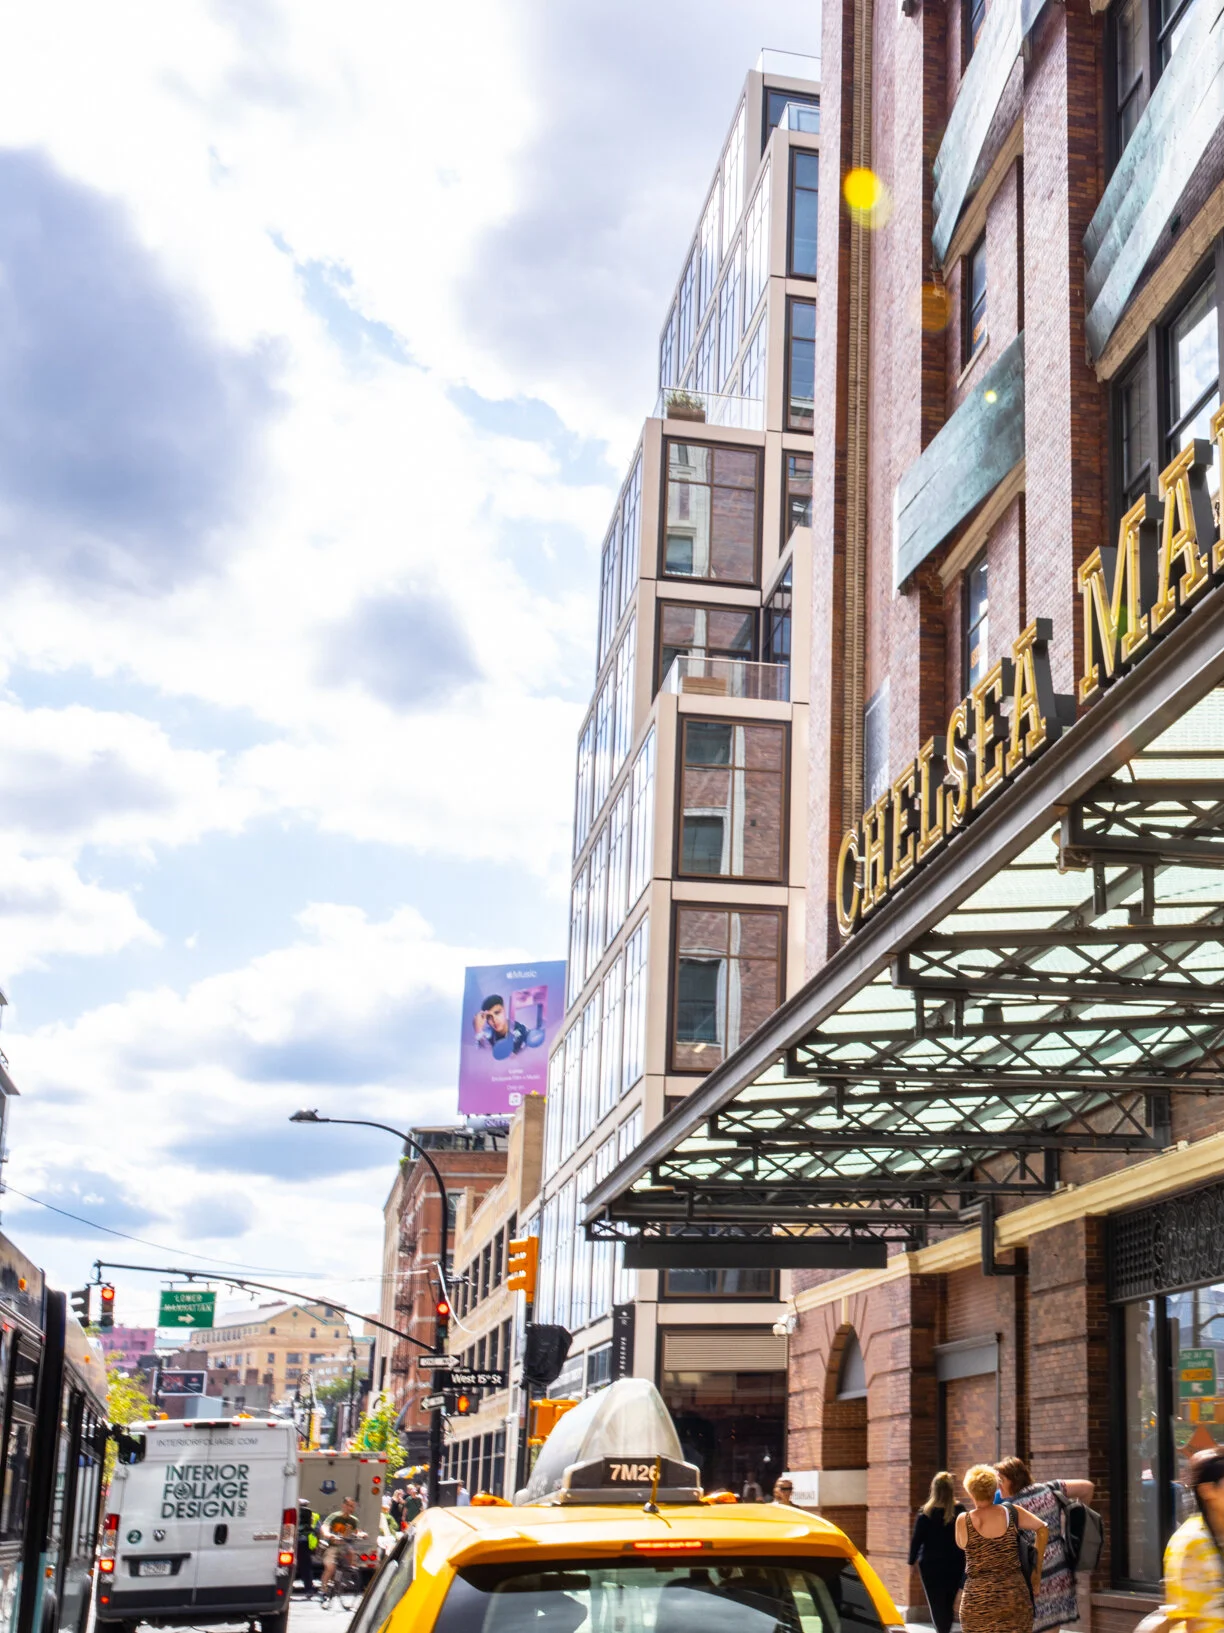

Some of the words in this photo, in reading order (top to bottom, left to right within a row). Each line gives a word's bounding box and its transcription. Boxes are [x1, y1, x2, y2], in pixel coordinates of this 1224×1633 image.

[836, 617, 1062, 937] CHELSEA
[512, 970, 537, 978] Music
[175, 1294, 203, 1302] LOWER
[164, 1303, 212, 1313] MANHATTAN
[619, 1337, 627, 1370] RESERVE
[451, 1373, 476, 1384] West
[491, 1373, 502, 1384] St
[165, 1464, 249, 1480] INTERIOR
[163, 1482, 248, 1500] FOLIAGE
[161, 1500, 235, 1518] DESIGN
